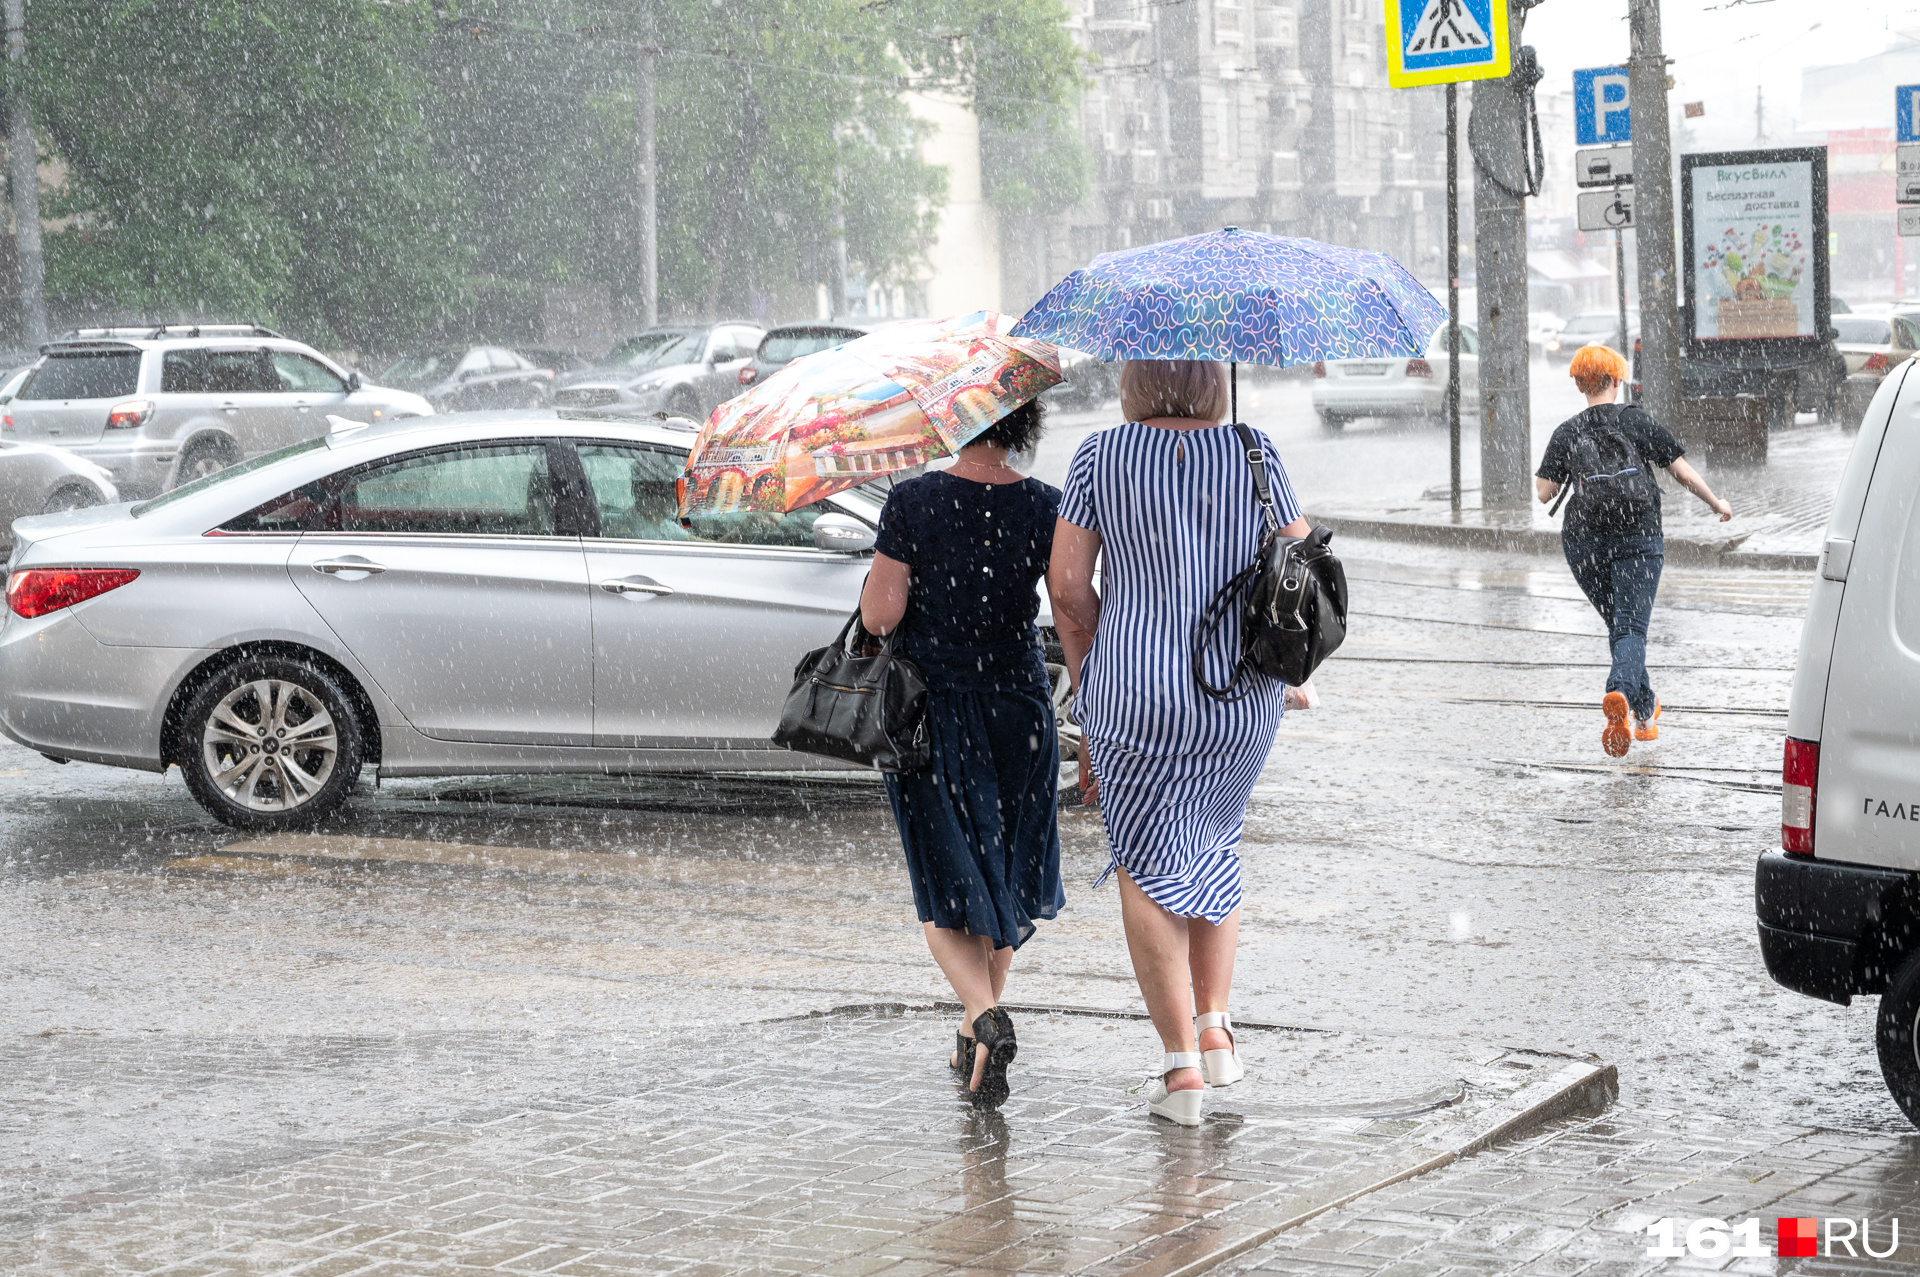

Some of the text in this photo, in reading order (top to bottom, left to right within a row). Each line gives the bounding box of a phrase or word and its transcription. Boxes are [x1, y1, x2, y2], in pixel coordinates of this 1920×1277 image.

[1594, 74, 1630, 136] P
[1706, 190, 1775, 201] Бесплатная
[1744, 201, 1800, 212] доставка
